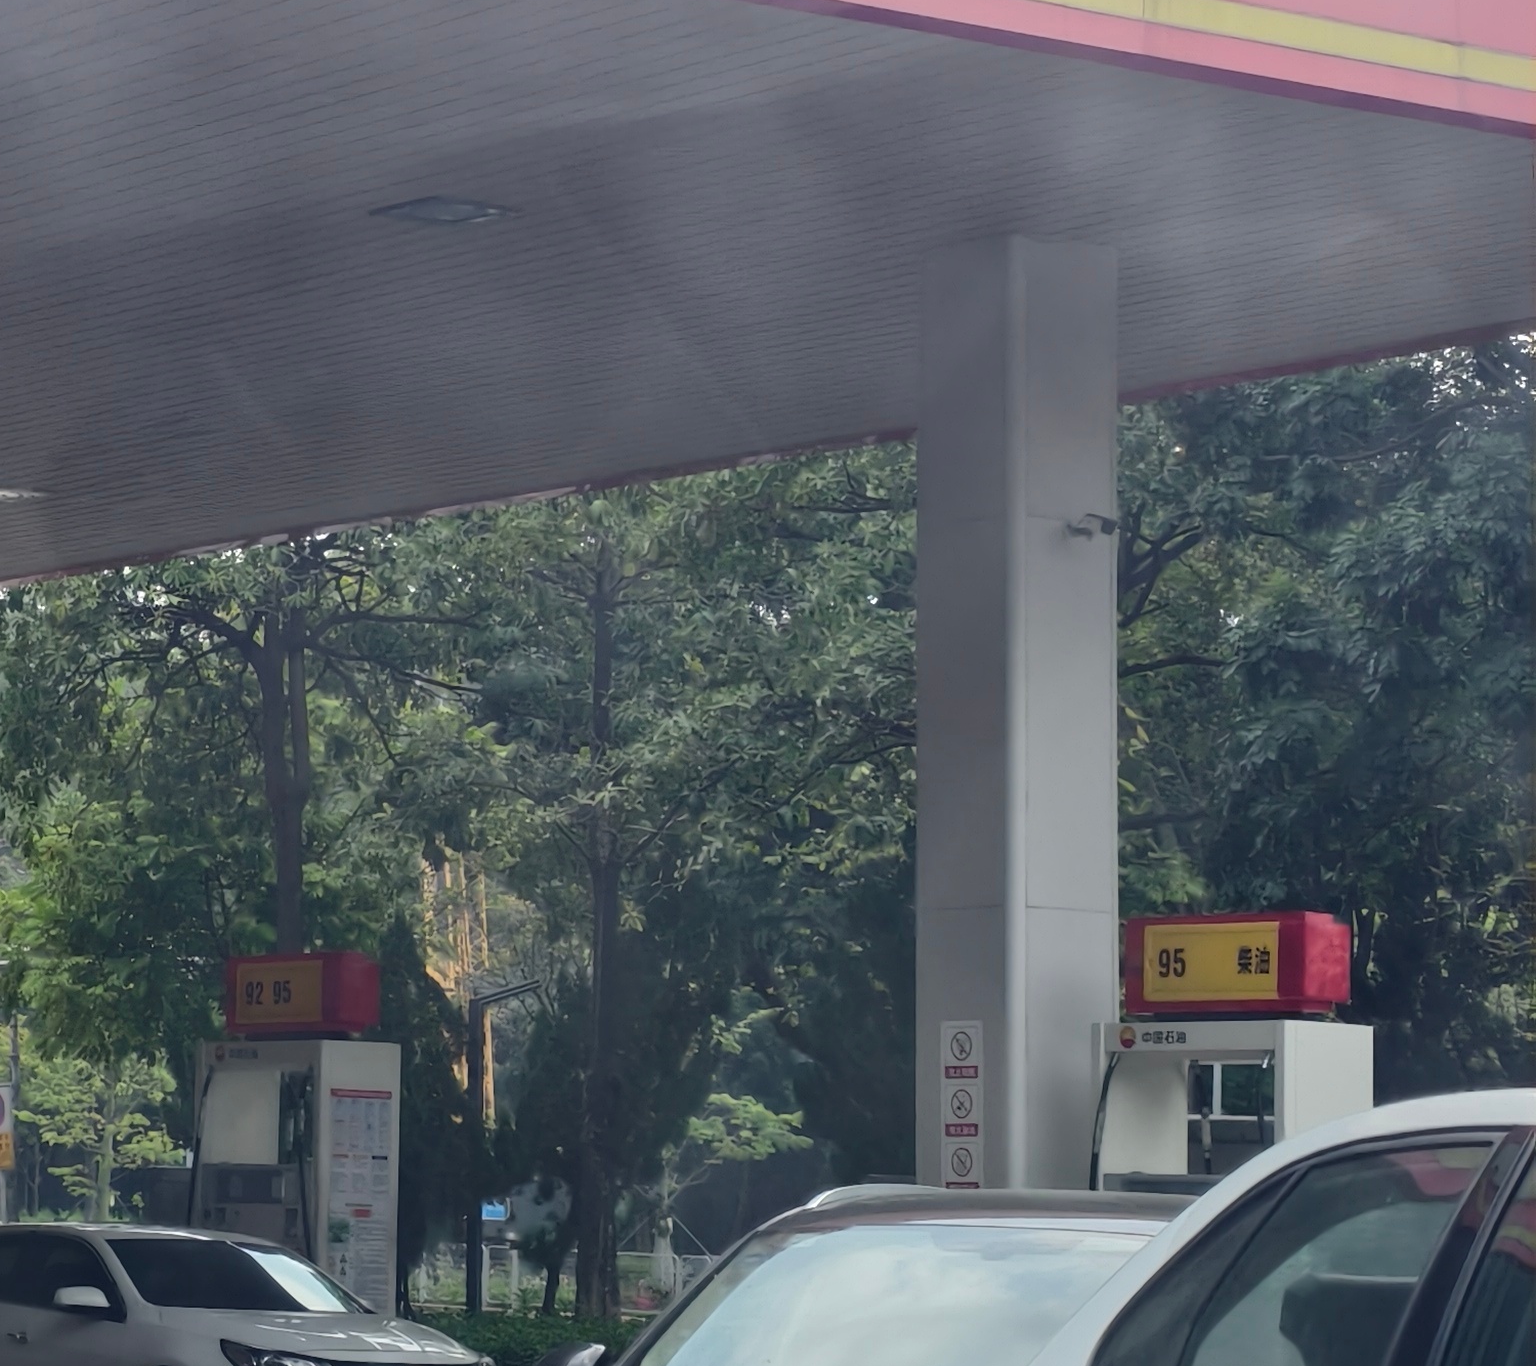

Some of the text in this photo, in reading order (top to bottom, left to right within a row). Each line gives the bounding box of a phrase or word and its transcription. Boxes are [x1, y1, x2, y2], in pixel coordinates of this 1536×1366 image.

[1158, 948, 1186, 977] 95
[1237, 945, 1271, 975] 柴油
[245, 980, 292, 1005] 92 95
